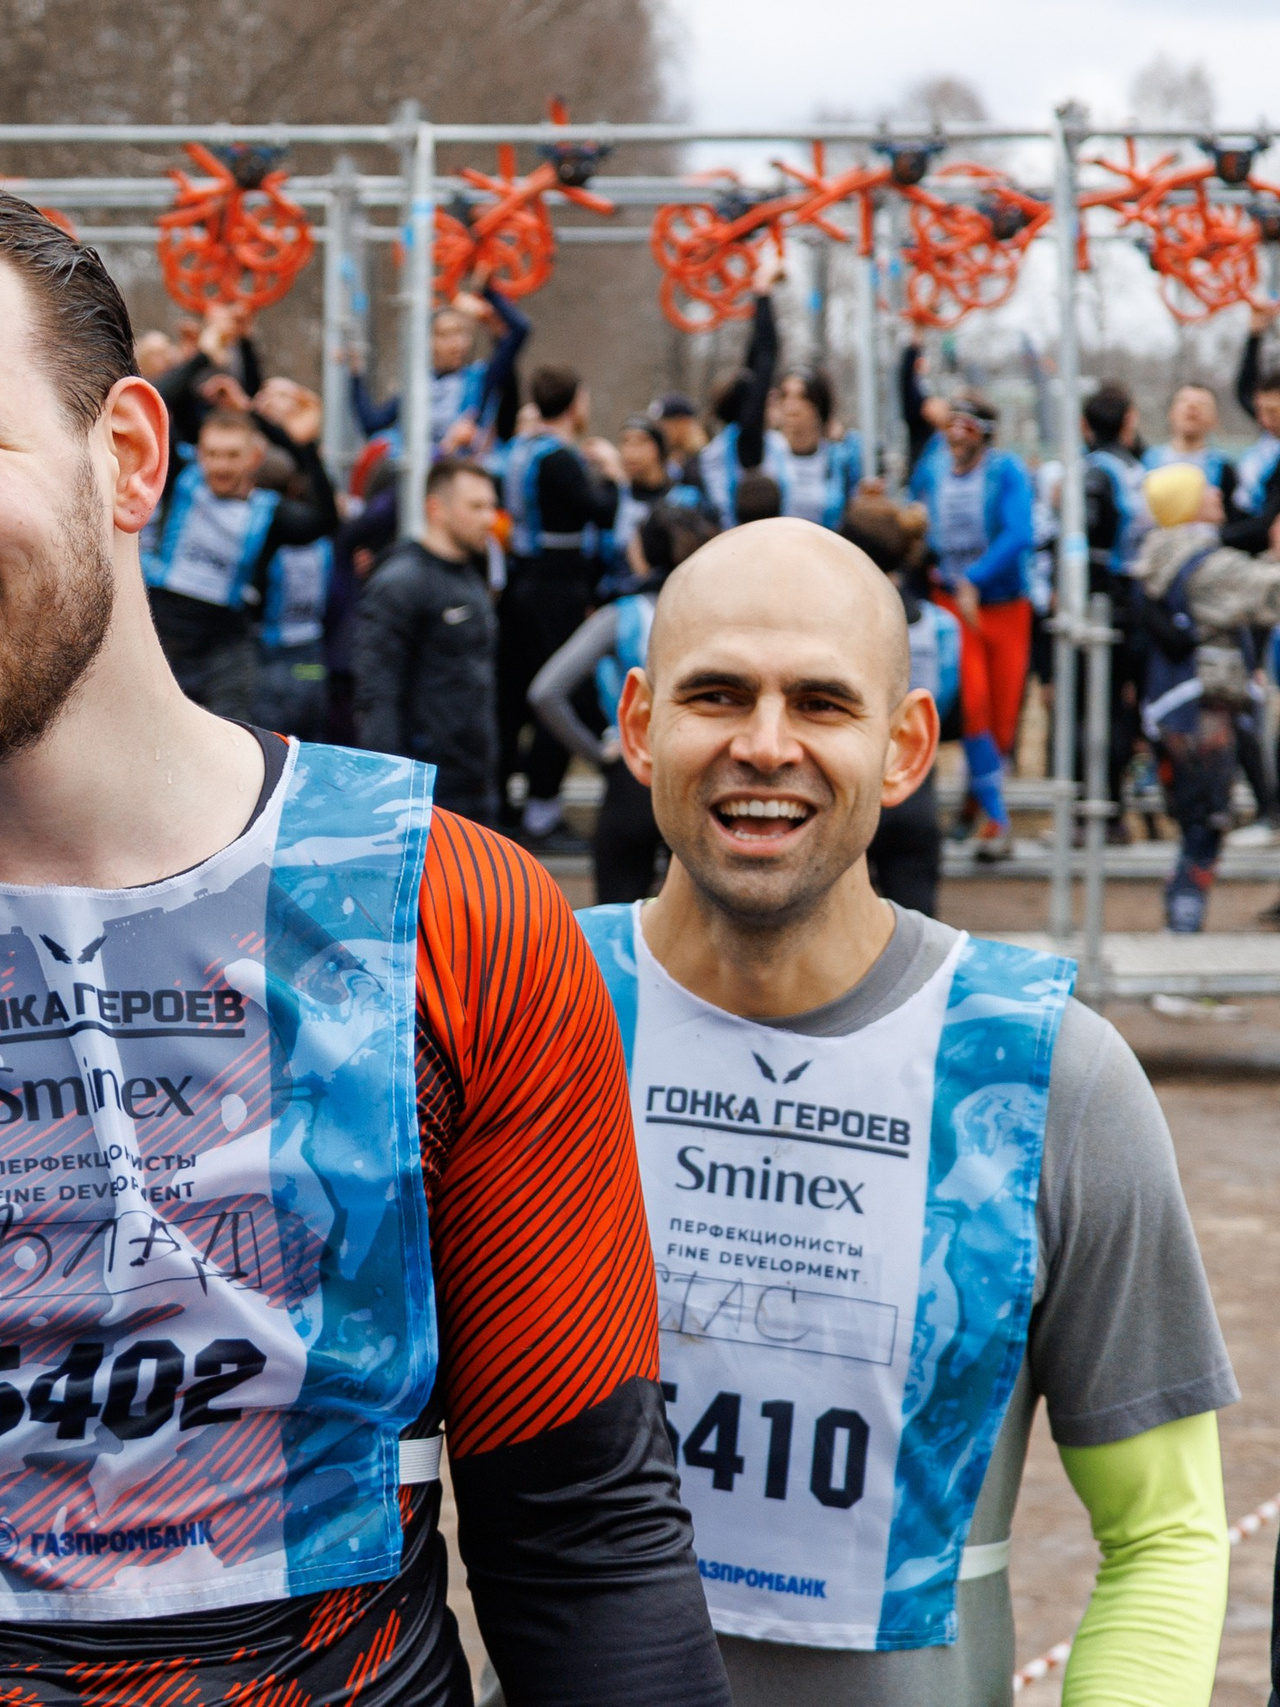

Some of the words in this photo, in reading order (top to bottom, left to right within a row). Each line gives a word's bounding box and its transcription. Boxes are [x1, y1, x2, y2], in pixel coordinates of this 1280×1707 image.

[73, 982, 246, 1024] ГЕРОЕВ
[646, 1085, 761, 1125] ГОНКА
[773, 1099, 911, 1146] ГЕРОЕВ
[674, 1144, 866, 1215] Sminex
[670, 1217, 864, 1258] ПЕРФЕКЦИОНИСТЫ
[667, 1243, 710, 1261] FINE
[719, 1250, 861, 1283] DEVELOPMENT
[30, 1518, 216, 1557] ГАЗПРОМБАНК
[696, 1557, 827, 1599] АЗПРОМБАНК
